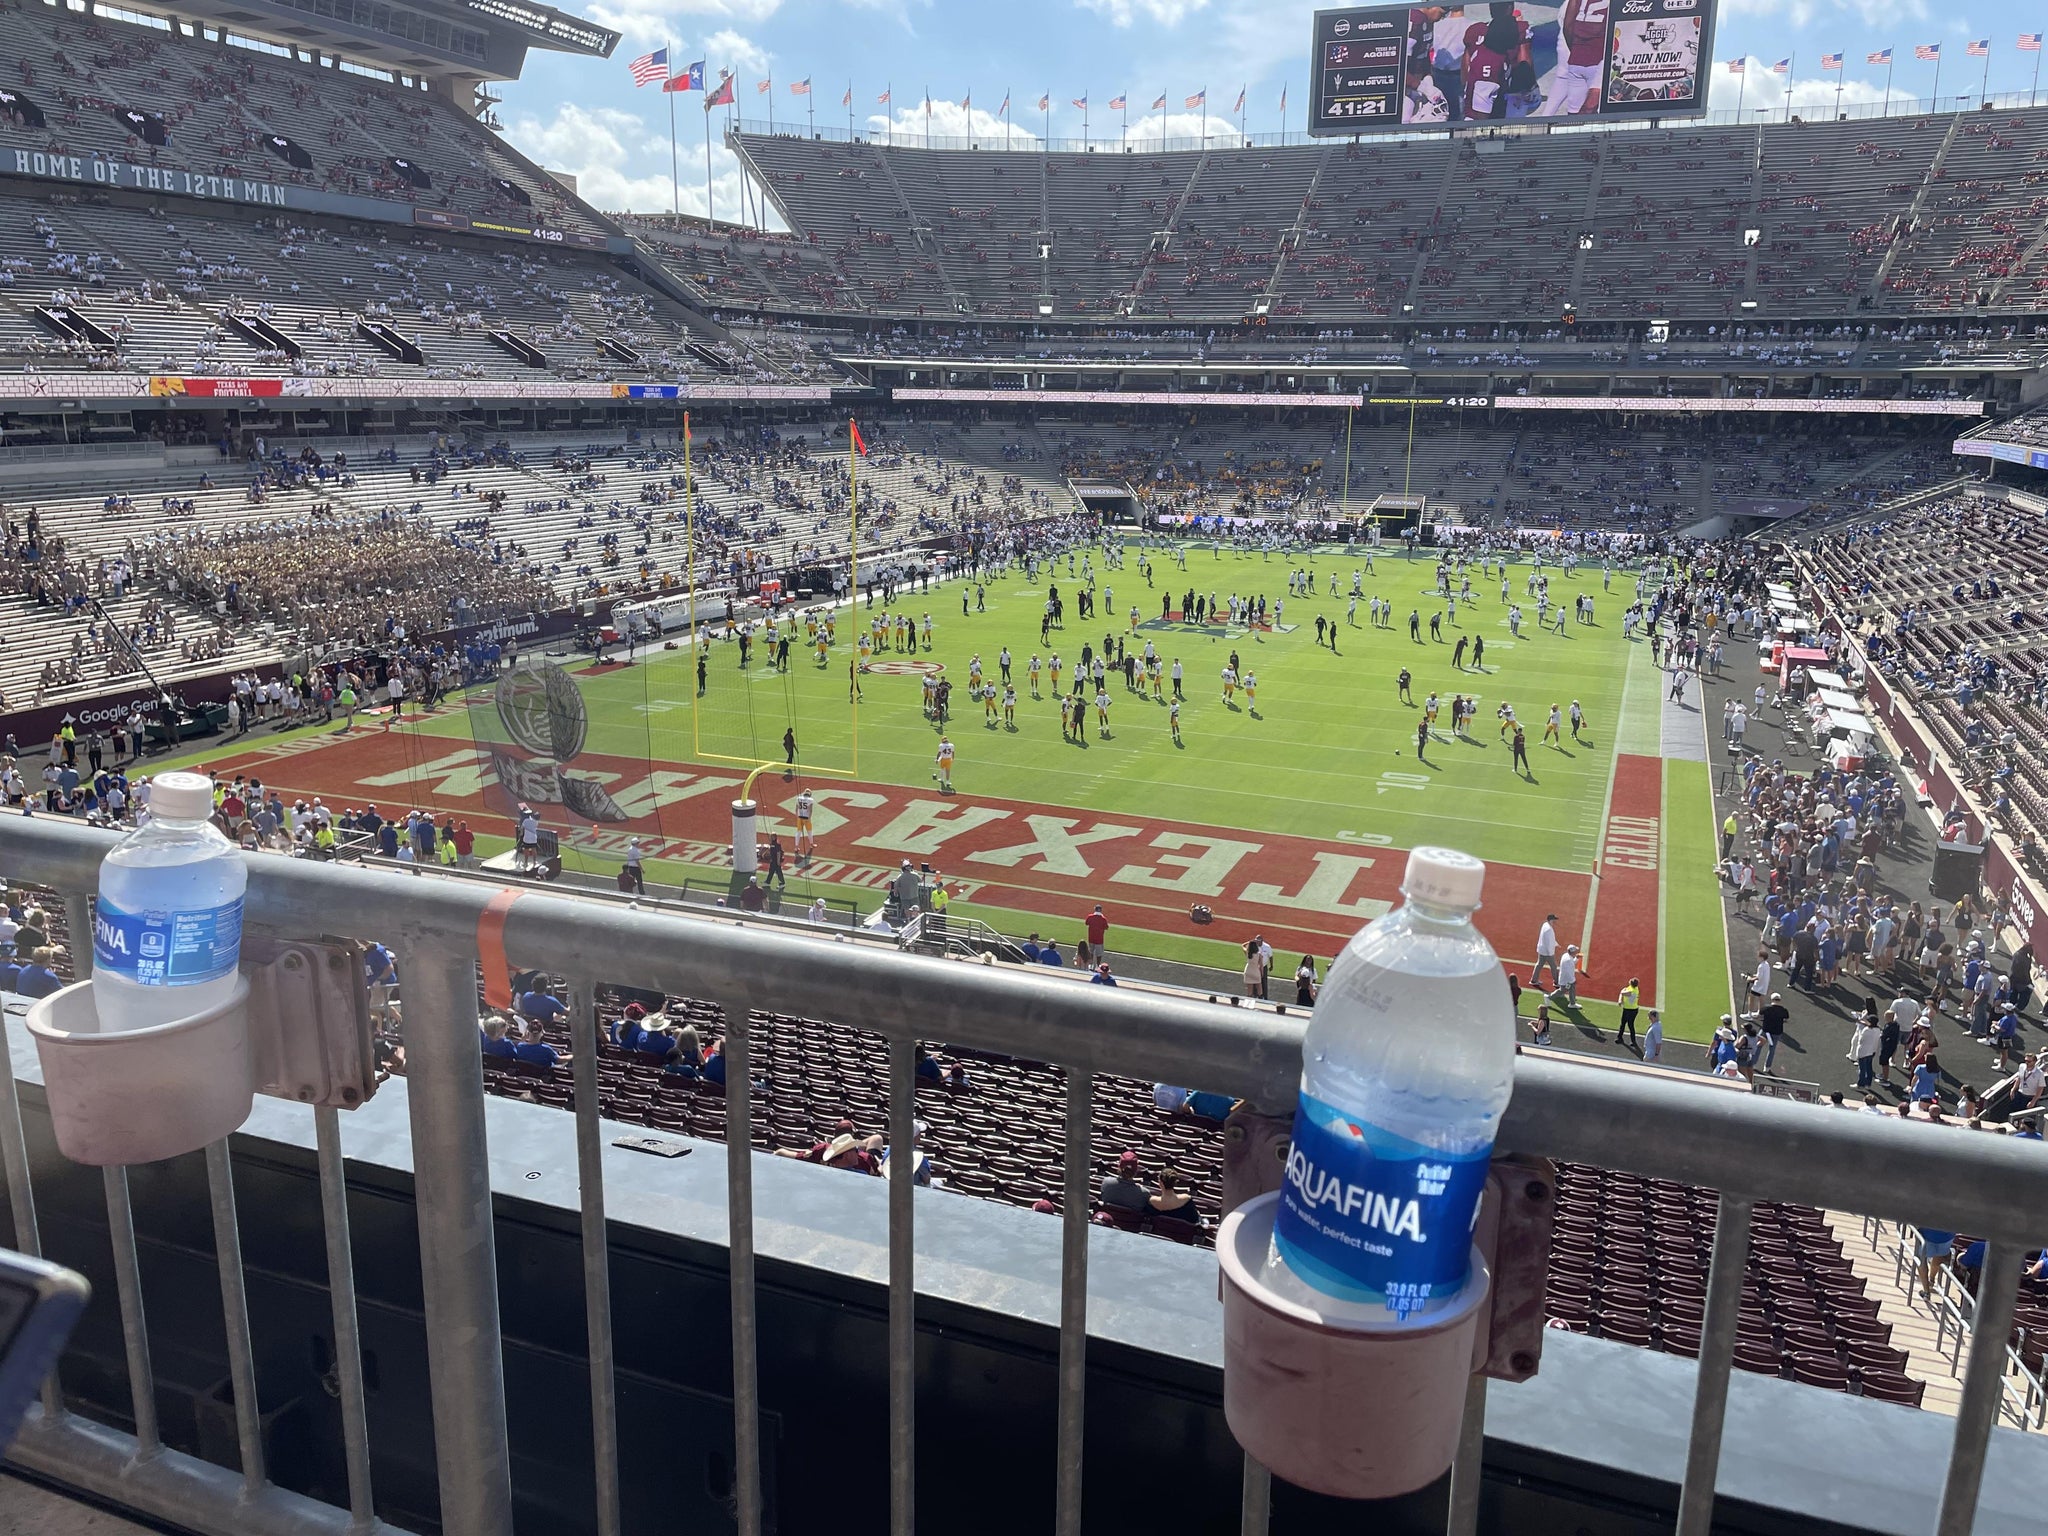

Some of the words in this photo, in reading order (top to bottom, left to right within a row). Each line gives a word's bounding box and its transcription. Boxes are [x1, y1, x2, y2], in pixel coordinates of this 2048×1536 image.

[1622, 0, 1653, 14] Ford
[1628, 53, 1653, 65] JOIN
[1654, 52, 1682, 63] NOW!
[1366, 78, 1394, 86] DEVILS
[1328, 100, 1386, 116] 41:21
[15, 150, 82, 179] HOME
[93, 160, 120, 184] OF
[130, 166, 175, 192] THE
[184, 172, 235, 199] 12TH
[244, 181, 286, 205] MAN
[533, 228, 563, 242] 41:20
[1562, 315, 1574, 324] 40
[214, 388, 254, 397] FOOTBALL
[1447, 397, 1488, 406] 41:20
[80, 704, 129, 724] Google
[942, 747, 952, 756] 43
[757, 788, 1401, 919] TEXAS
[839, 866, 987, 902] LND
[2012, 876, 2034, 928] Govee
[176, 914, 212, 922] Nutrition
[1284, 1141, 1421, 1244] AQUAFINA
[1298, 1209, 1322, 1232] water,
[1322, 1225, 1362, 1249] perfect
[1364, 1240, 1393, 1257] taste
[1385, 1282, 1408, 1296] 33.8
[1408, 1283, 1418, 1297] FL
[1420, 1283, 1432, 1297] OZ
[1386, 1297, 1410, 1311] (1.05
